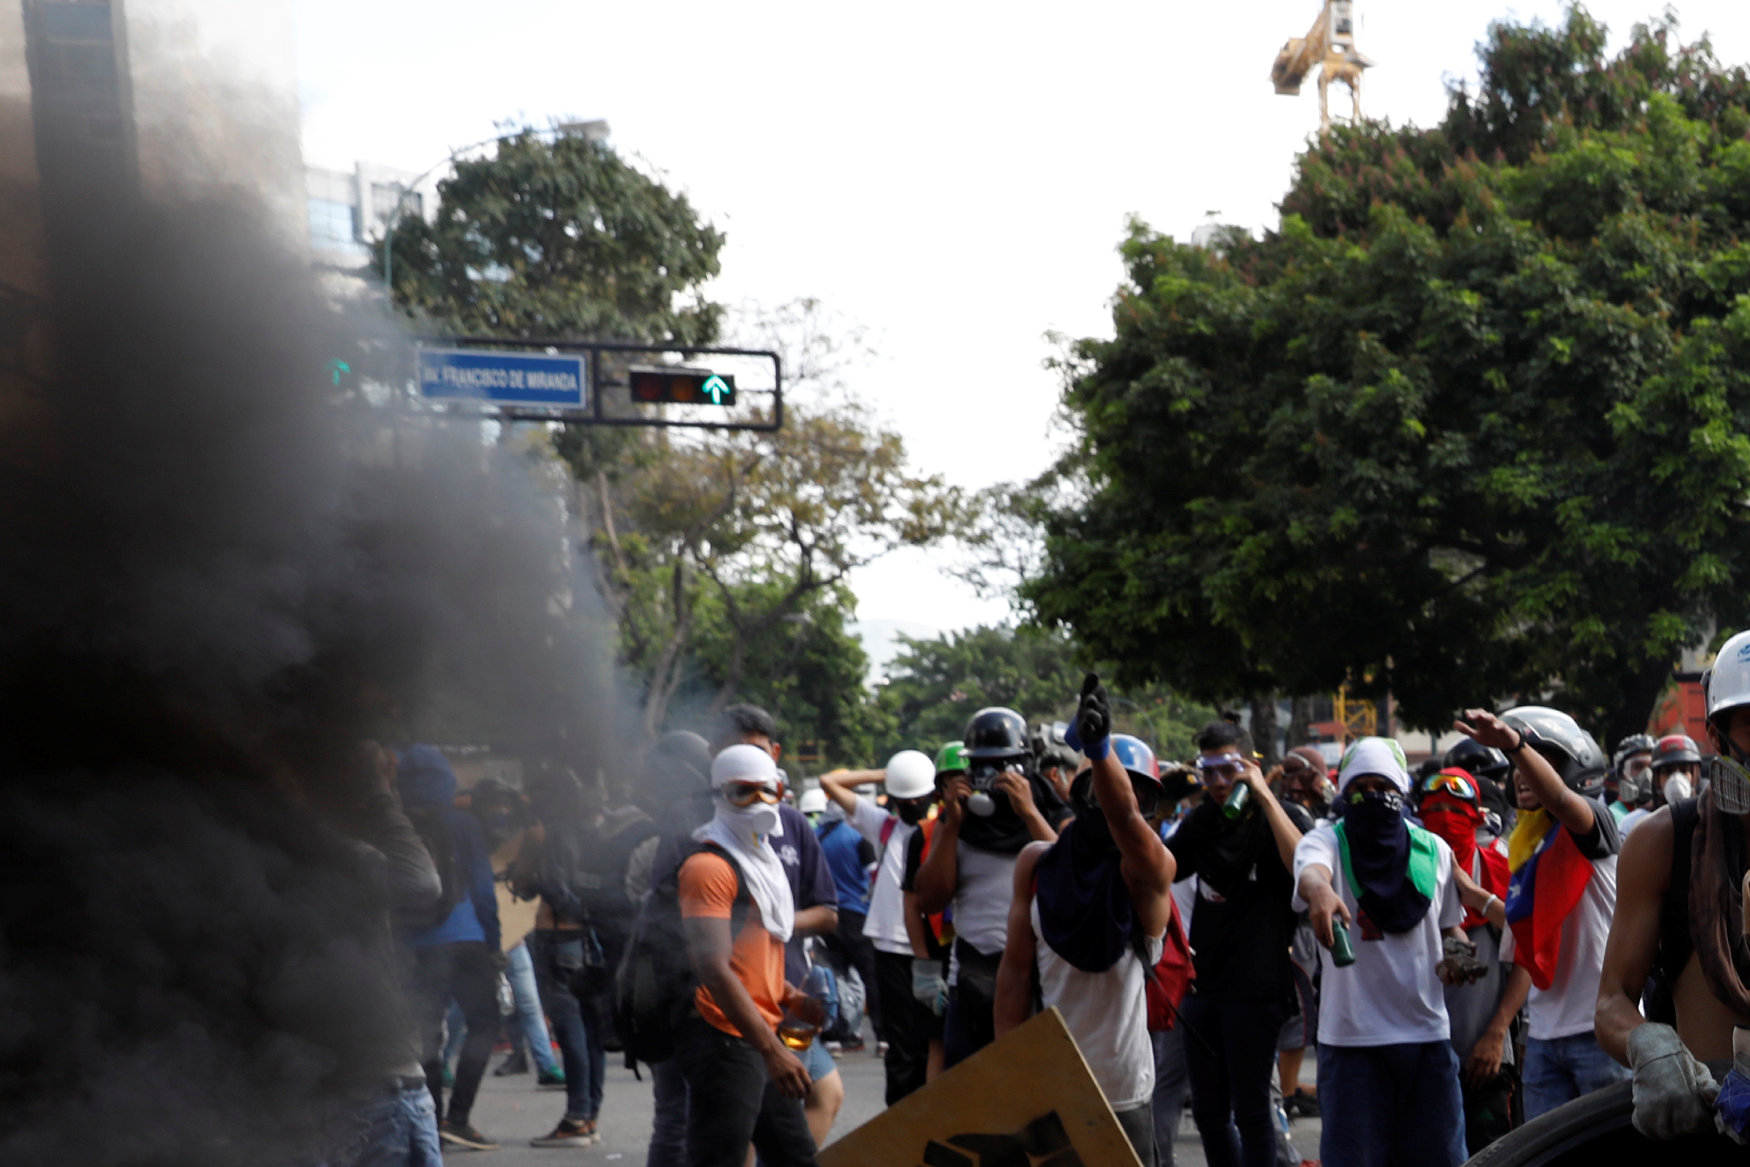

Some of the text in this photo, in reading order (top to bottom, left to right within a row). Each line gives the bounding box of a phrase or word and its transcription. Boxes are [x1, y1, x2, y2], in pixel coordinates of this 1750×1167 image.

[443, 364, 507, 388] FRANCISCO
[508, 368, 525, 390] DE
[526, 370, 579, 393] MIRANDA
